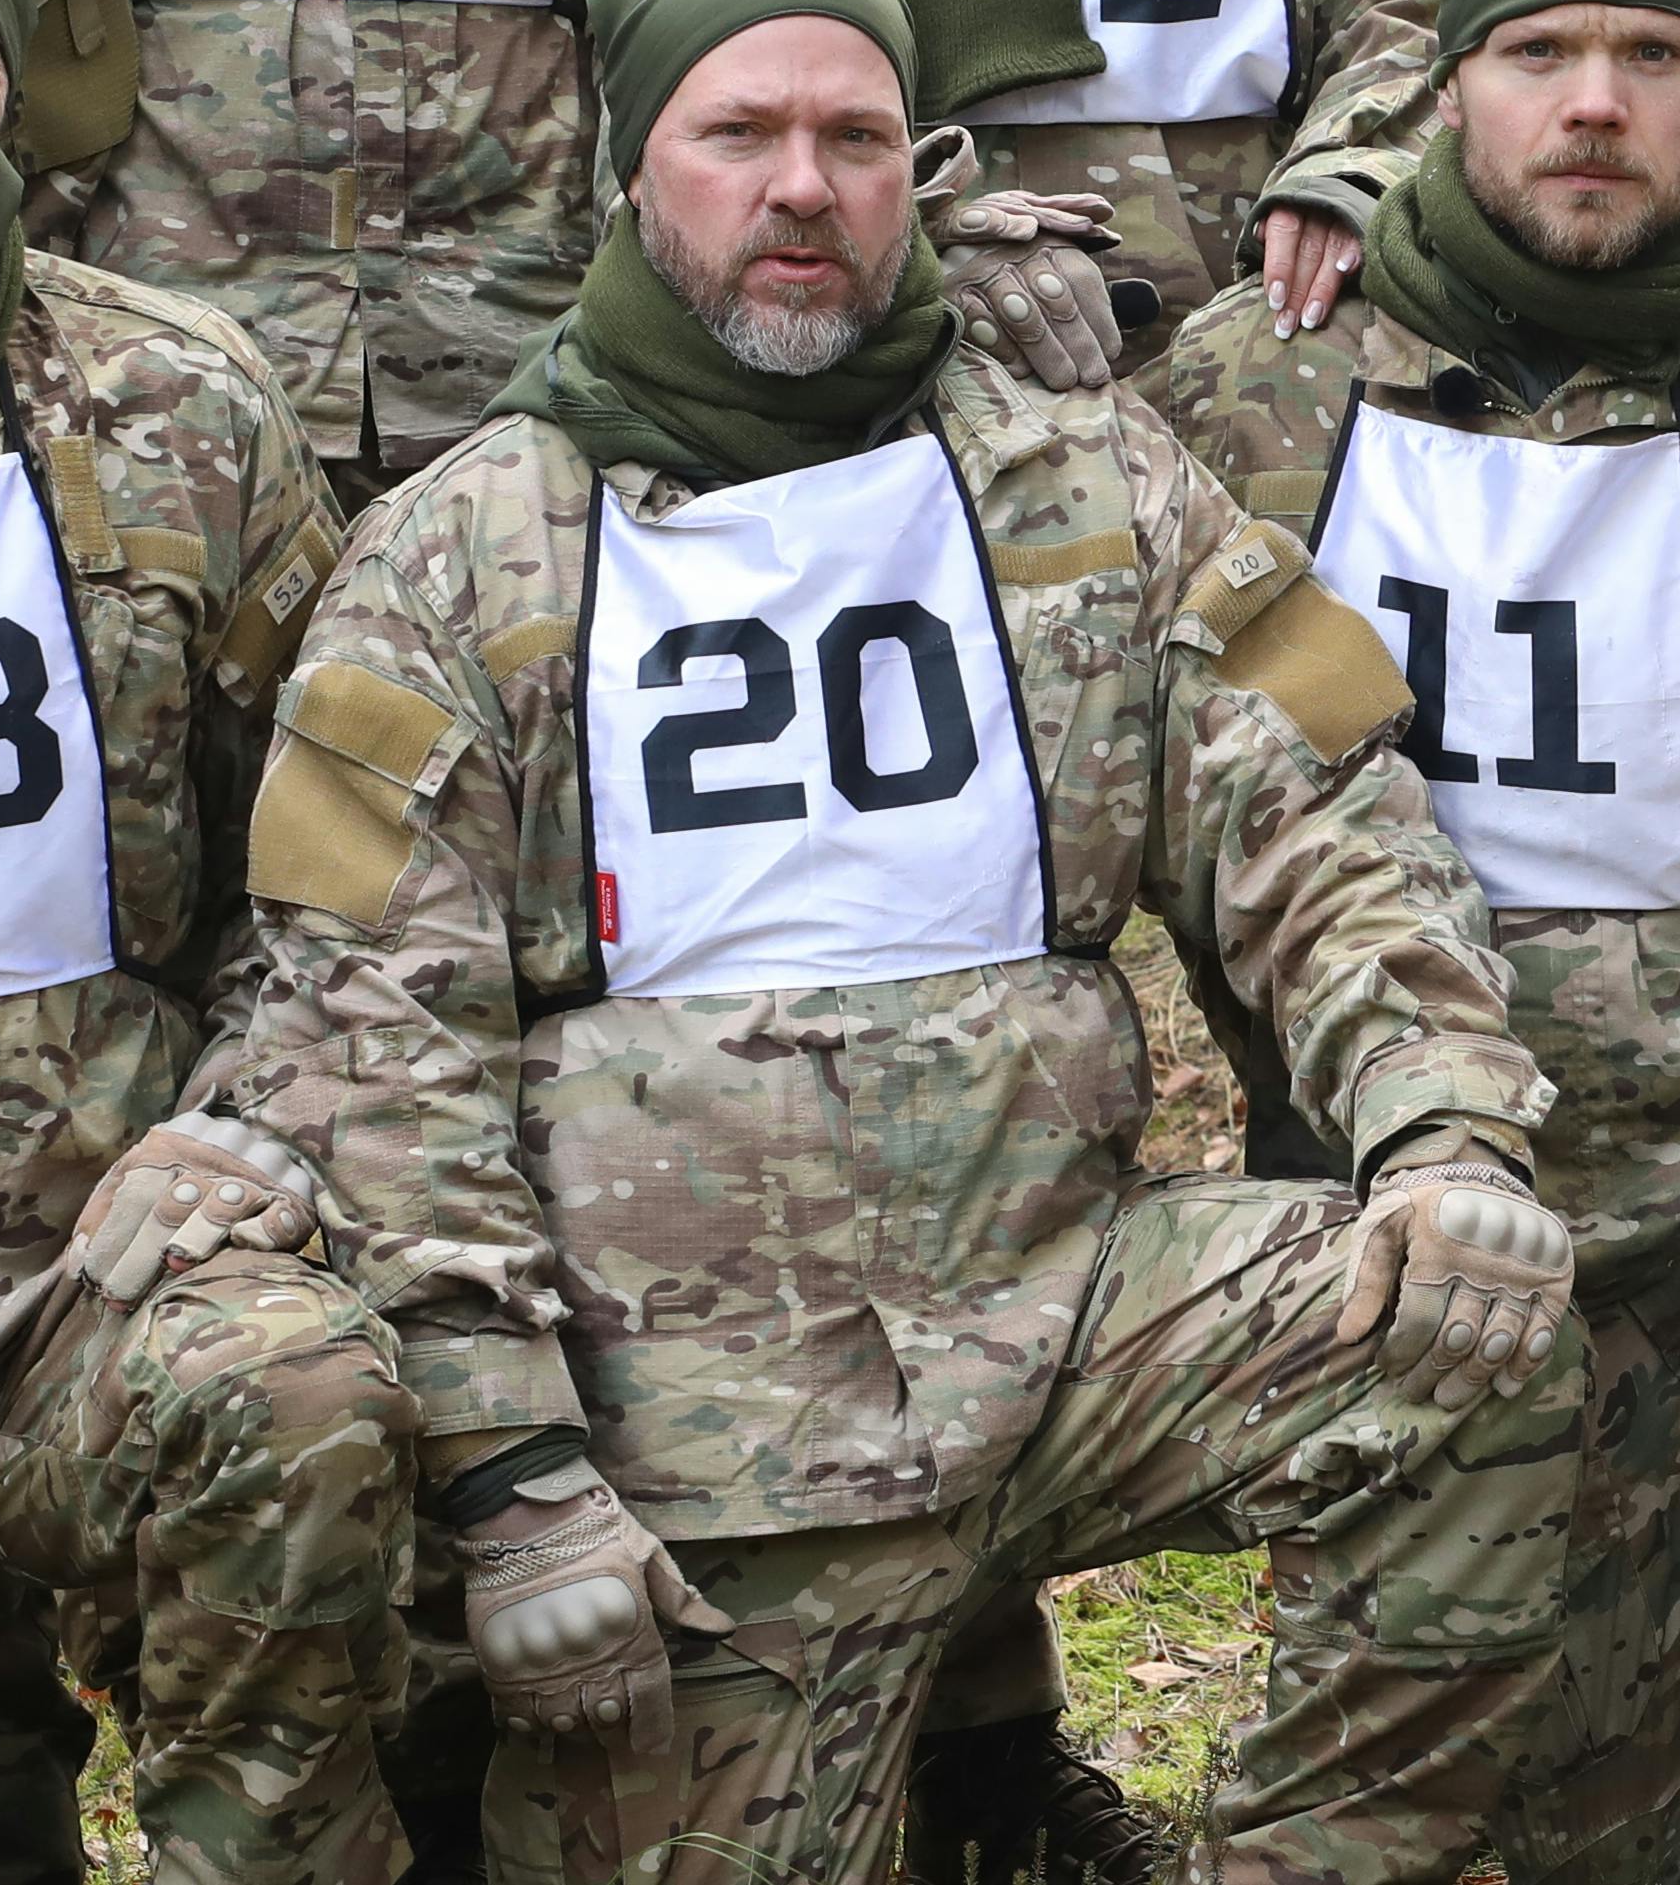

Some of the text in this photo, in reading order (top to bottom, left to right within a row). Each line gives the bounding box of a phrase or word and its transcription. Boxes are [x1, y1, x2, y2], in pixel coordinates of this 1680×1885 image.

[273, 571, 304, 611] 53
[1231, 553, 1260, 580] 20
[637, 599, 980, 835] 20
[1378, 574, 1616, 795] 11
